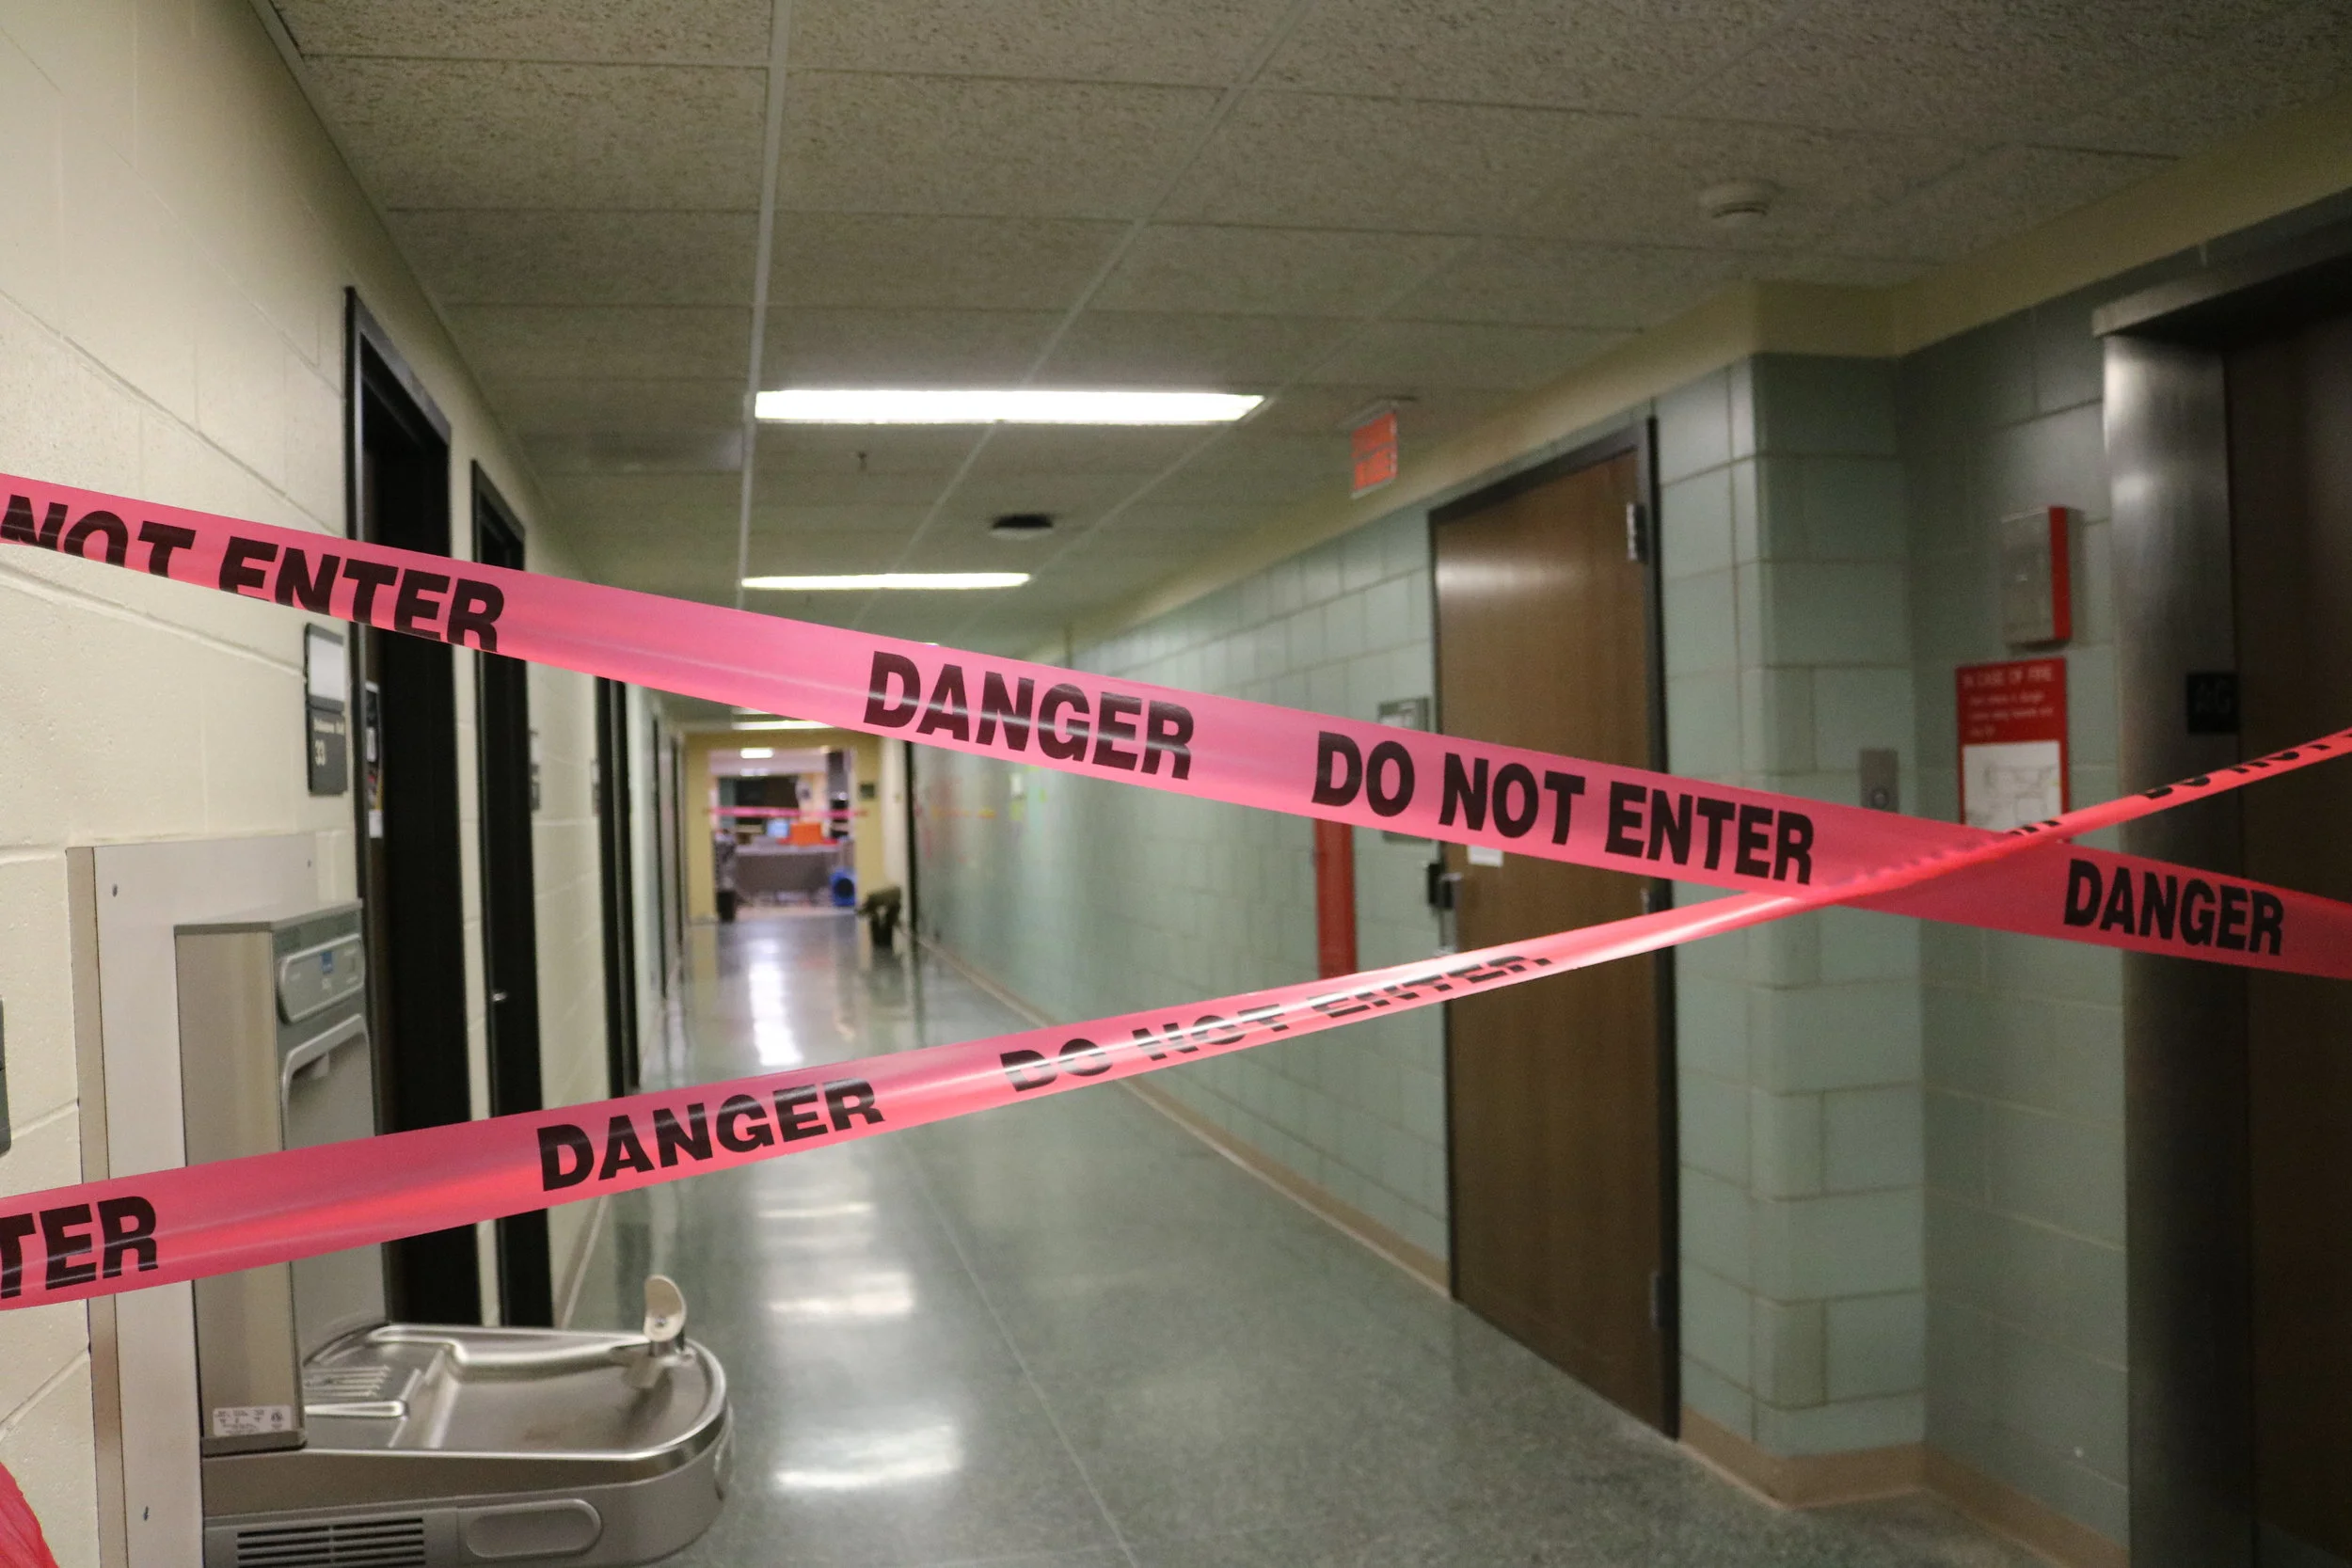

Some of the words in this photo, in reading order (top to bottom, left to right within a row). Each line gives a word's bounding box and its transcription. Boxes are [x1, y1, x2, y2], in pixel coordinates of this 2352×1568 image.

[0, 494, 196, 578] NOT
[219, 536, 505, 653] ENTER
[864, 650, 1194, 780] DANGER
[1311, 731, 1416, 817] DO
[1438, 752, 1586, 845] NOT
[1605, 780, 1814, 884] ENTER
[2063, 859, 2285, 957] DANGER
[1000, 1038, 1113, 1092] DO
[1132, 1004, 1290, 1062] NOT
[537, 1081, 884, 1192] DANGER
[0, 1196, 159, 1300] TER
